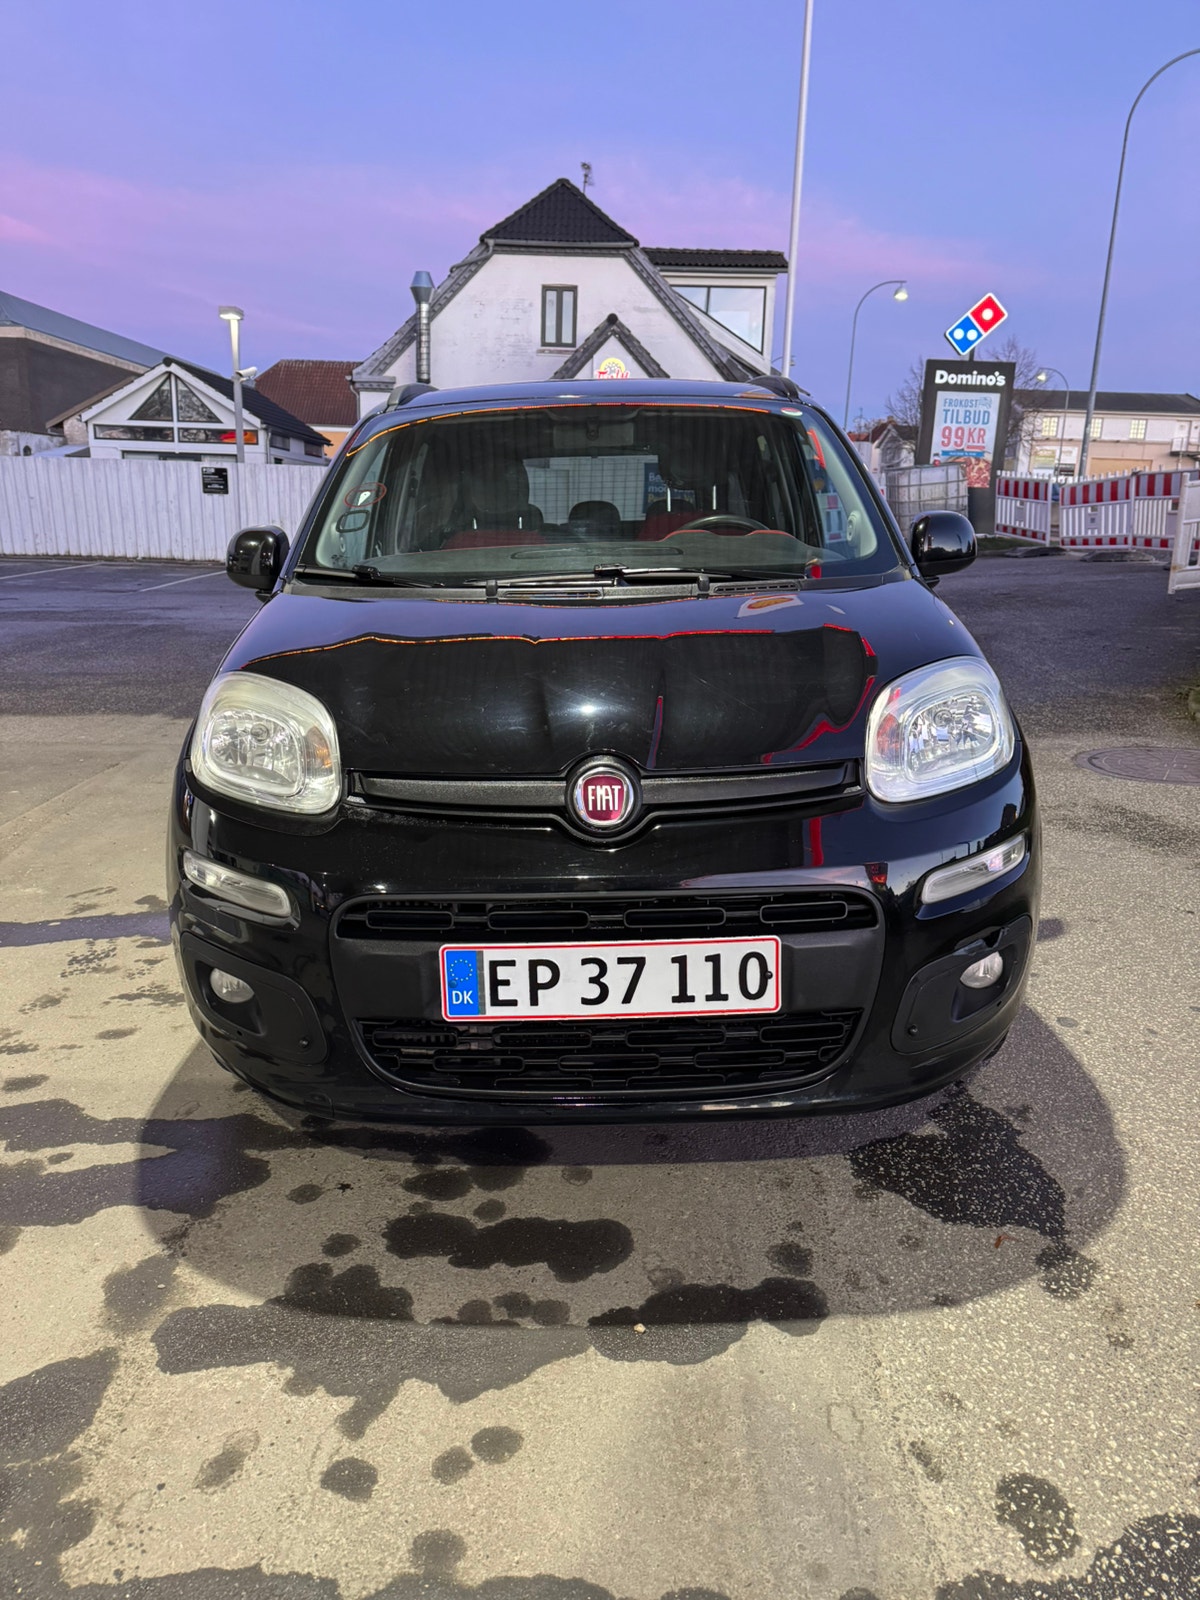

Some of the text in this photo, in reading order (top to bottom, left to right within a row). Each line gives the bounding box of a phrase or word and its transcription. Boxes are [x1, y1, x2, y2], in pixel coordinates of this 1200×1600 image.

[935, 370, 1006, 386] Domino's
[943, 398, 979, 408] FROKOST
[943, 409, 990, 425] TILBUD
[941, 425, 986, 448] 99 KR
[587, 785, 621, 811] FIAT
[489, 951, 769, 1007] EP 37 110
[451, 990, 473, 1005] DK
